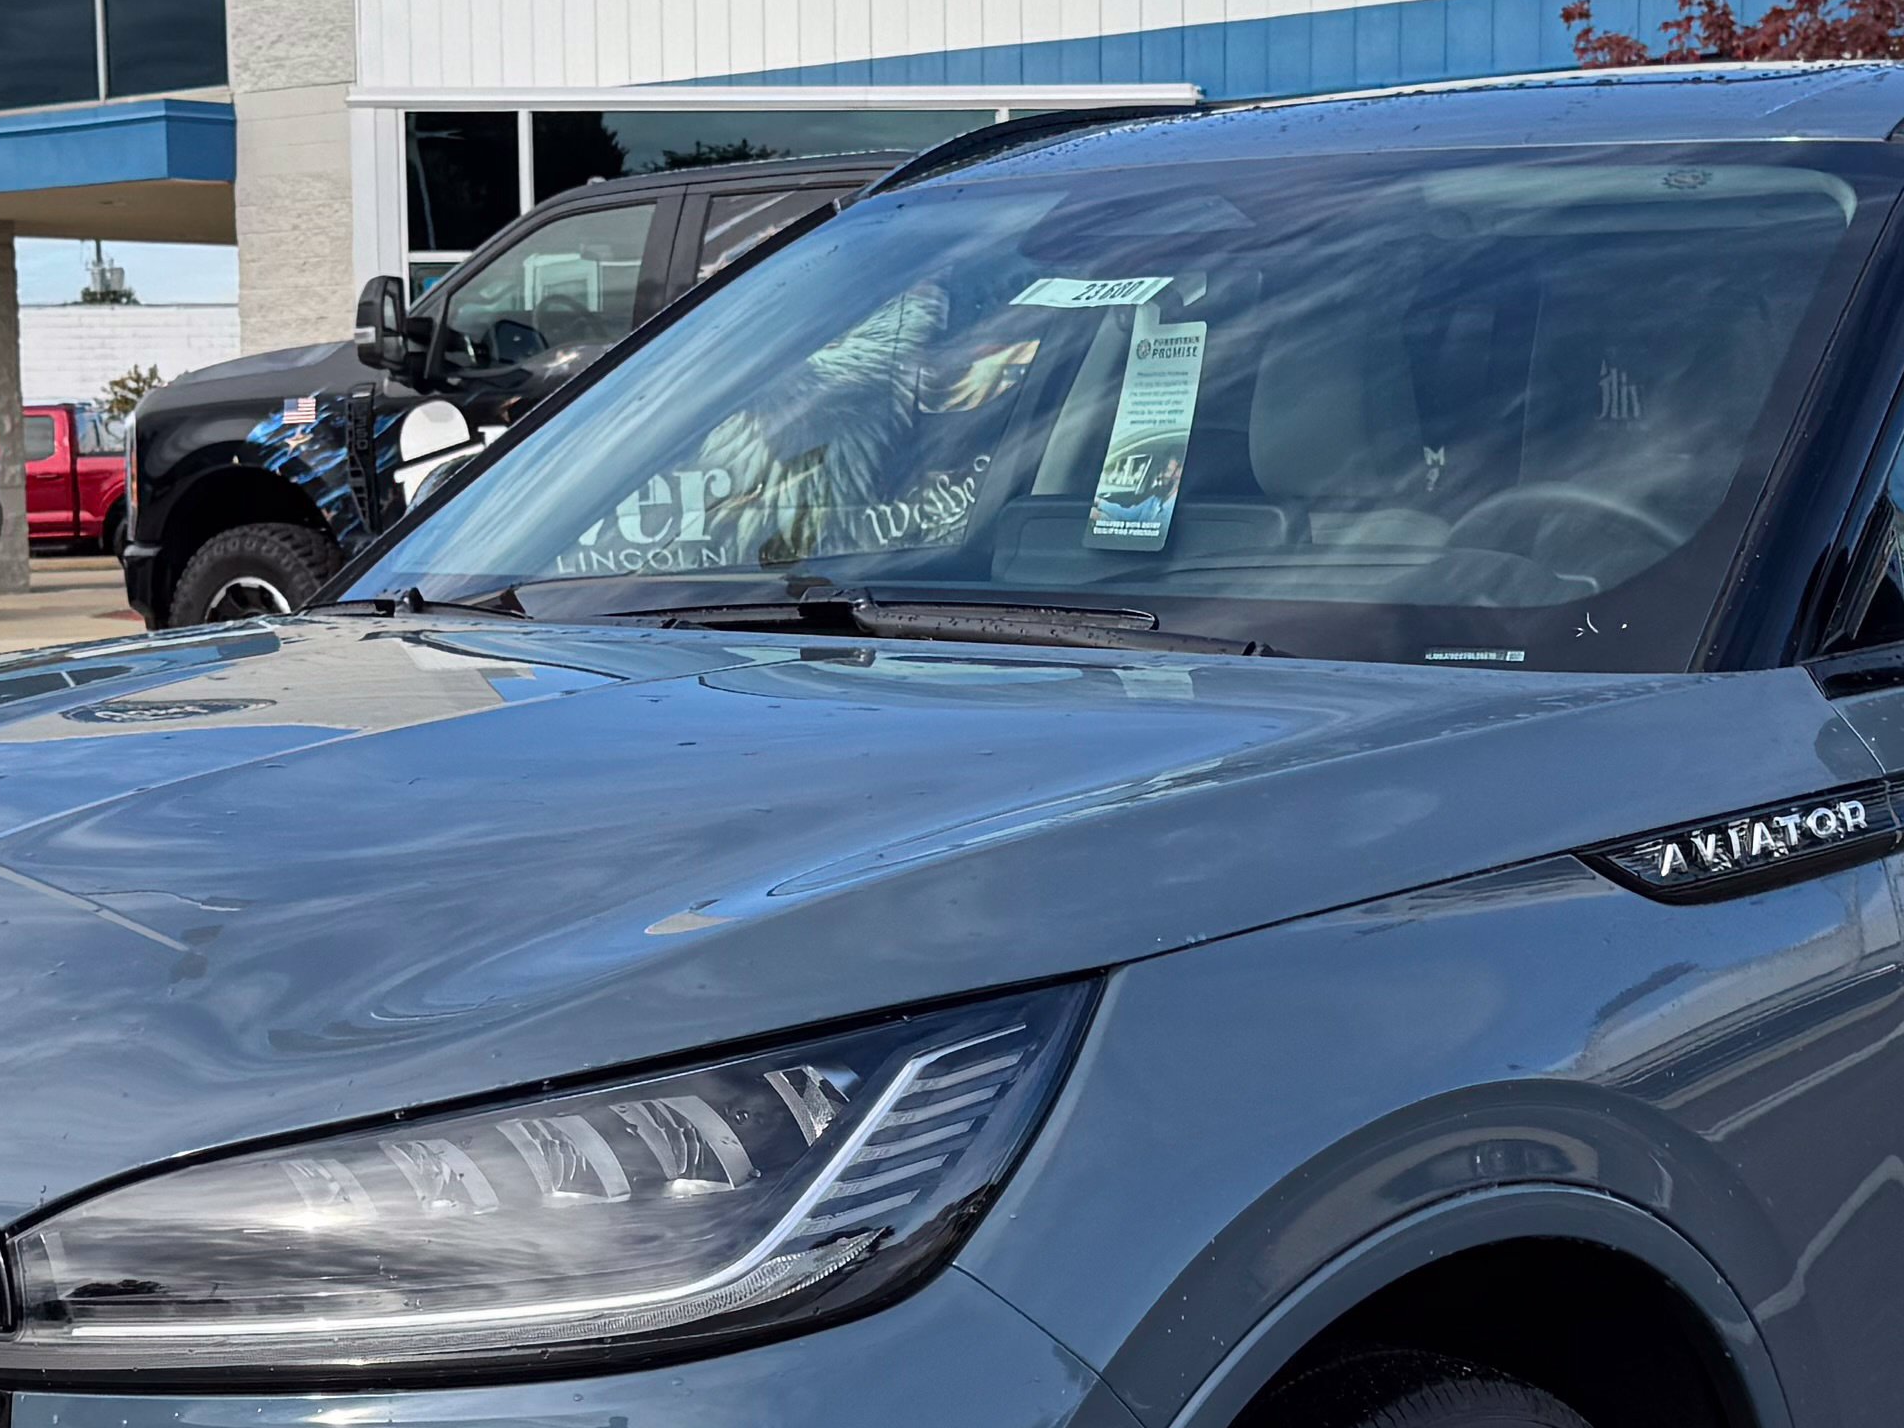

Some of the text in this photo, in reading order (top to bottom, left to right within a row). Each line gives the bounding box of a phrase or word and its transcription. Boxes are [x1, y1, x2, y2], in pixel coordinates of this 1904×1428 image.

[1151, 346, 1198, 359] PROMISE
[556, 546, 727, 574] LINCOLN
[1659, 799, 1869, 877] AVIATOR
